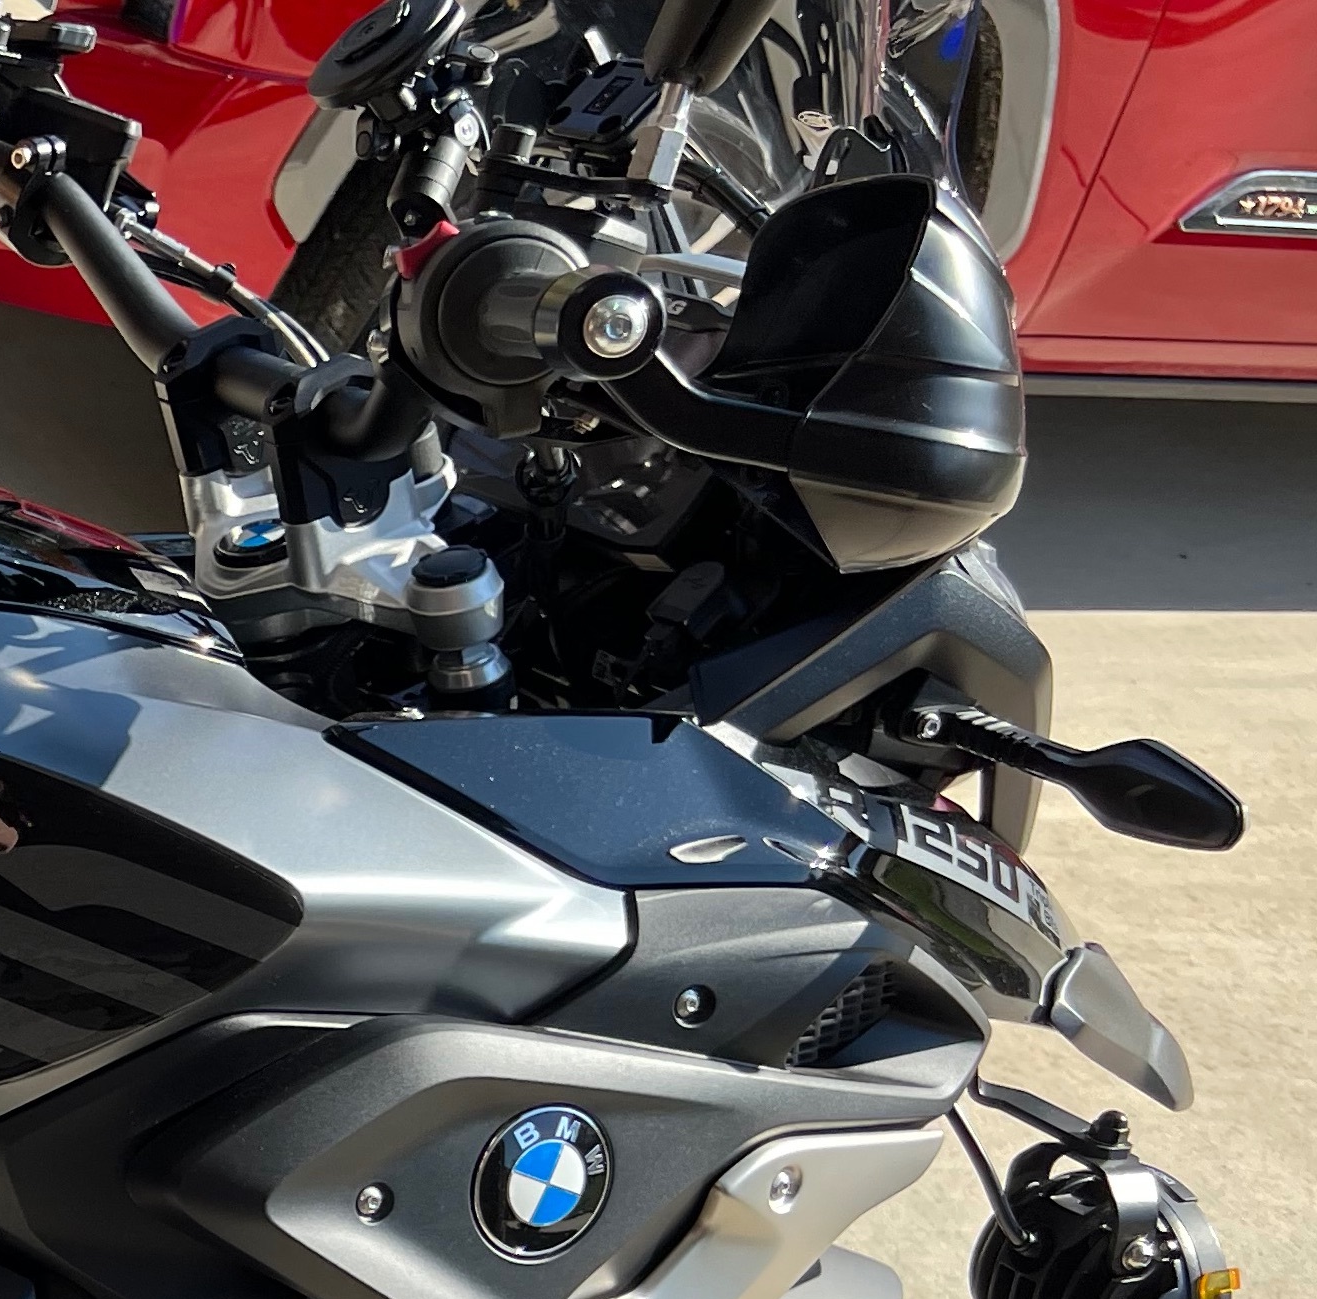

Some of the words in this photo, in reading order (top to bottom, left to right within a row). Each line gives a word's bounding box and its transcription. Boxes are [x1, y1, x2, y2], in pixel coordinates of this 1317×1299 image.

[1256, 195, 1307, 219] 1794
[877, 798, 1020, 904] 1250
[513, 1115, 605, 1176] BMW
